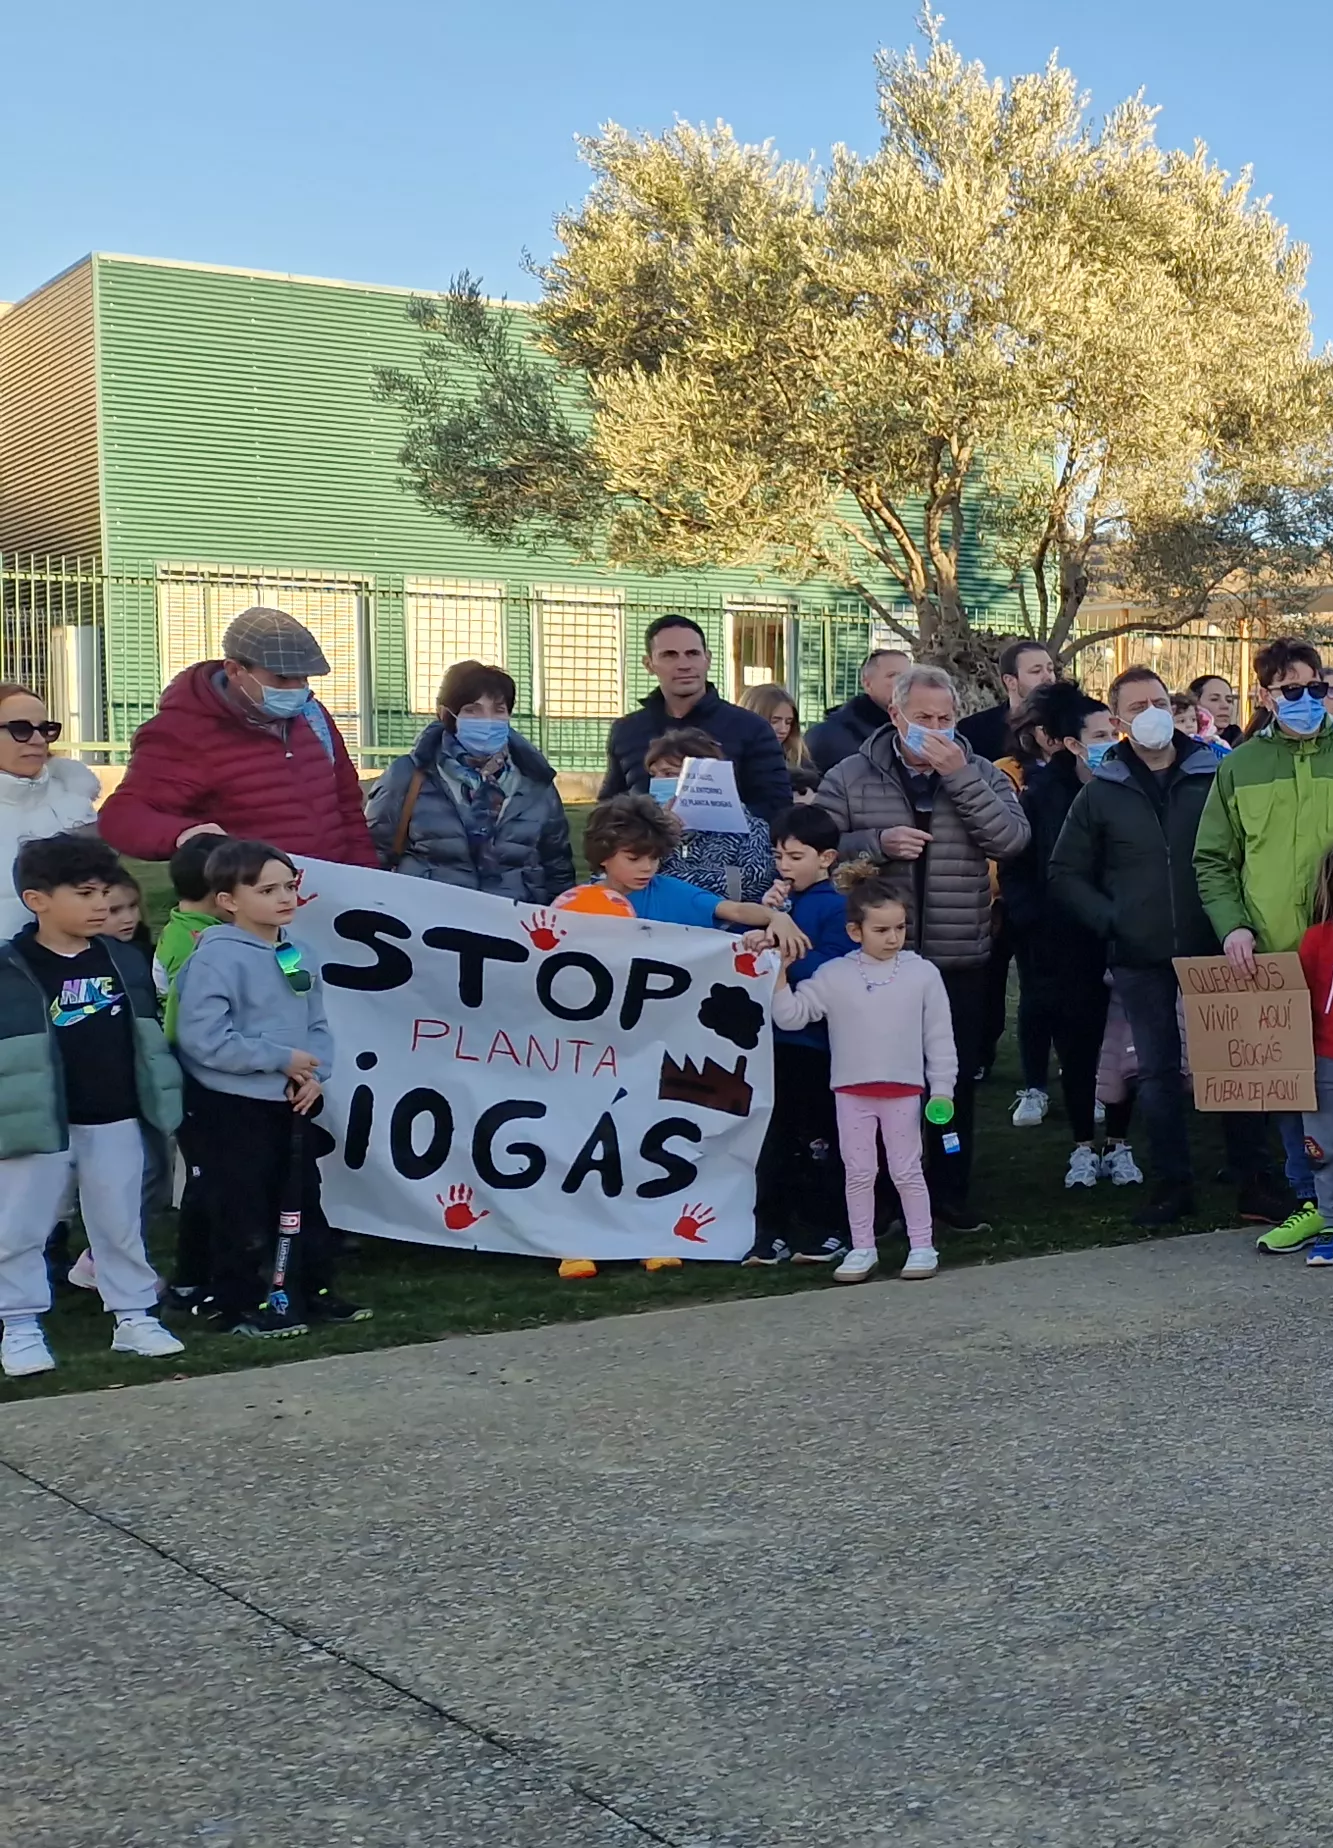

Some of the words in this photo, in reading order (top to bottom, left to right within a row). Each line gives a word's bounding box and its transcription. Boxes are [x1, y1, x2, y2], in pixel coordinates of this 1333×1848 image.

[60, 976, 113, 1006] NIKE
[321, 908, 693, 1031] STOP
[411, 1018, 618, 1077] PLANTA
[1204, 1077, 1245, 1105] FUERA
